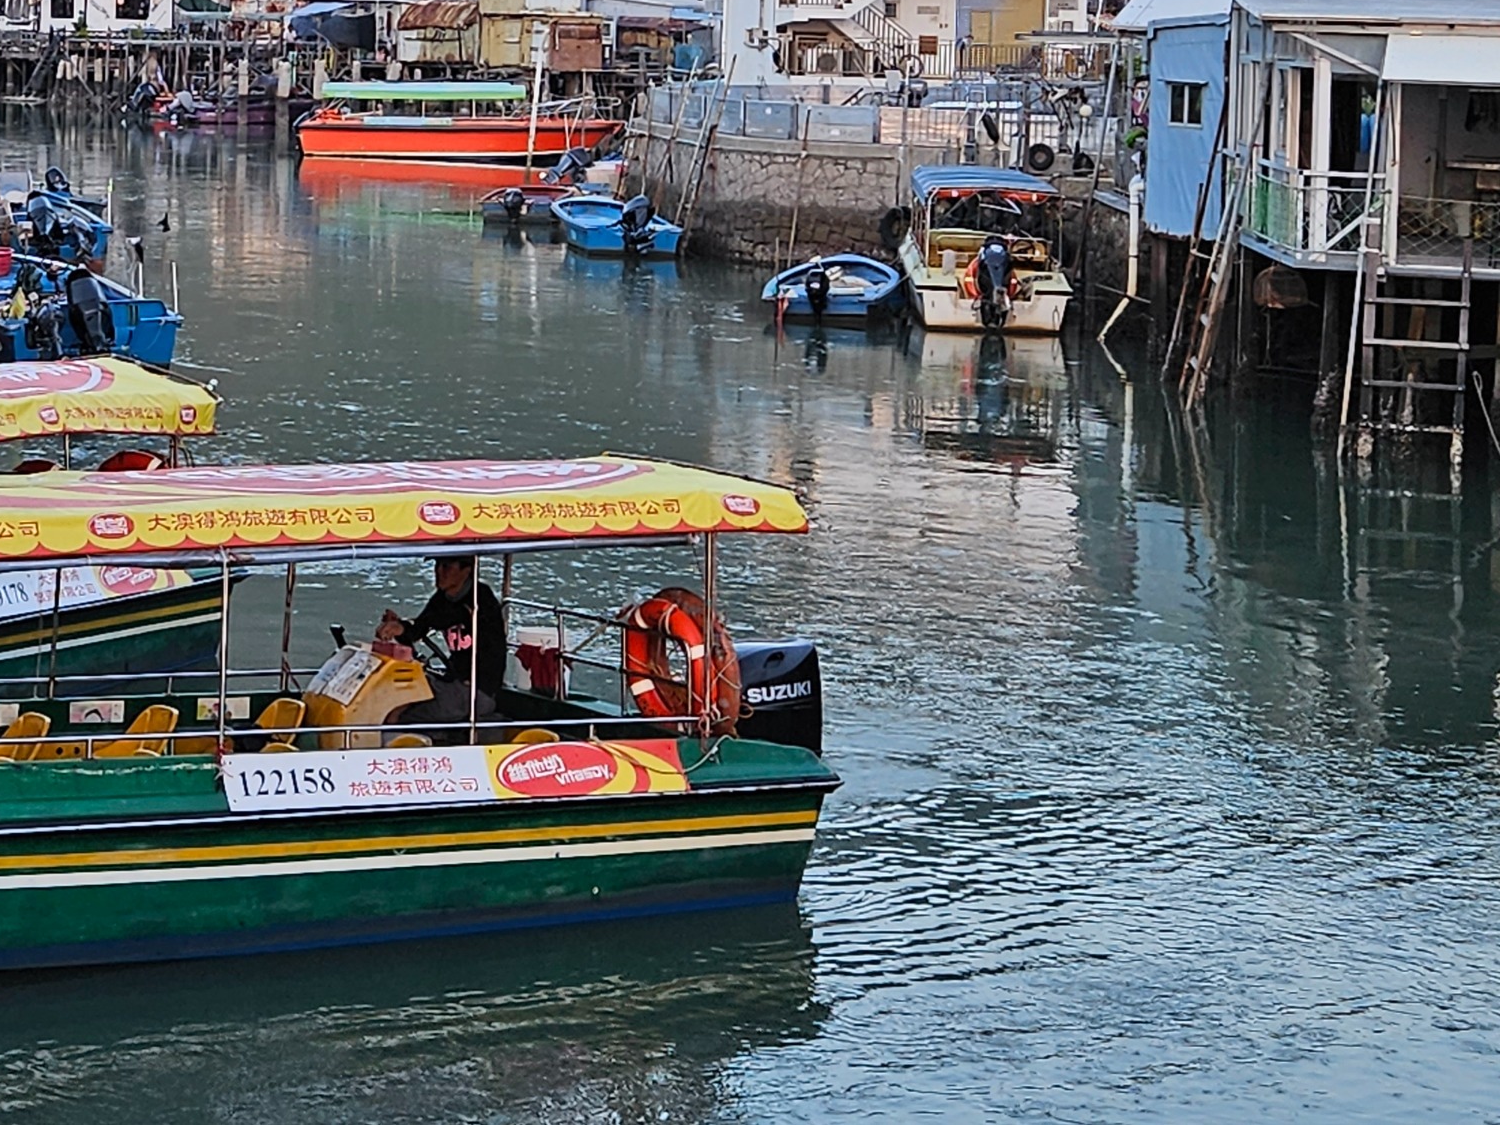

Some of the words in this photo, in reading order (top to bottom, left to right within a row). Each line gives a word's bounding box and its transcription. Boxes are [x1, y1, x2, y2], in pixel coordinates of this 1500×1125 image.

[147, 507, 376, 532] 大澳得鴻旅遊有限公司
[472, 498, 681, 520] 大澳得鴻旅遊有限公司
[746, 680, 812, 703] SUZUKI
[366, 756, 453, 775] 大澳得鴻
[239, 767, 336, 797] 122158
[349, 777, 479, 798] 旅遊有限公司
